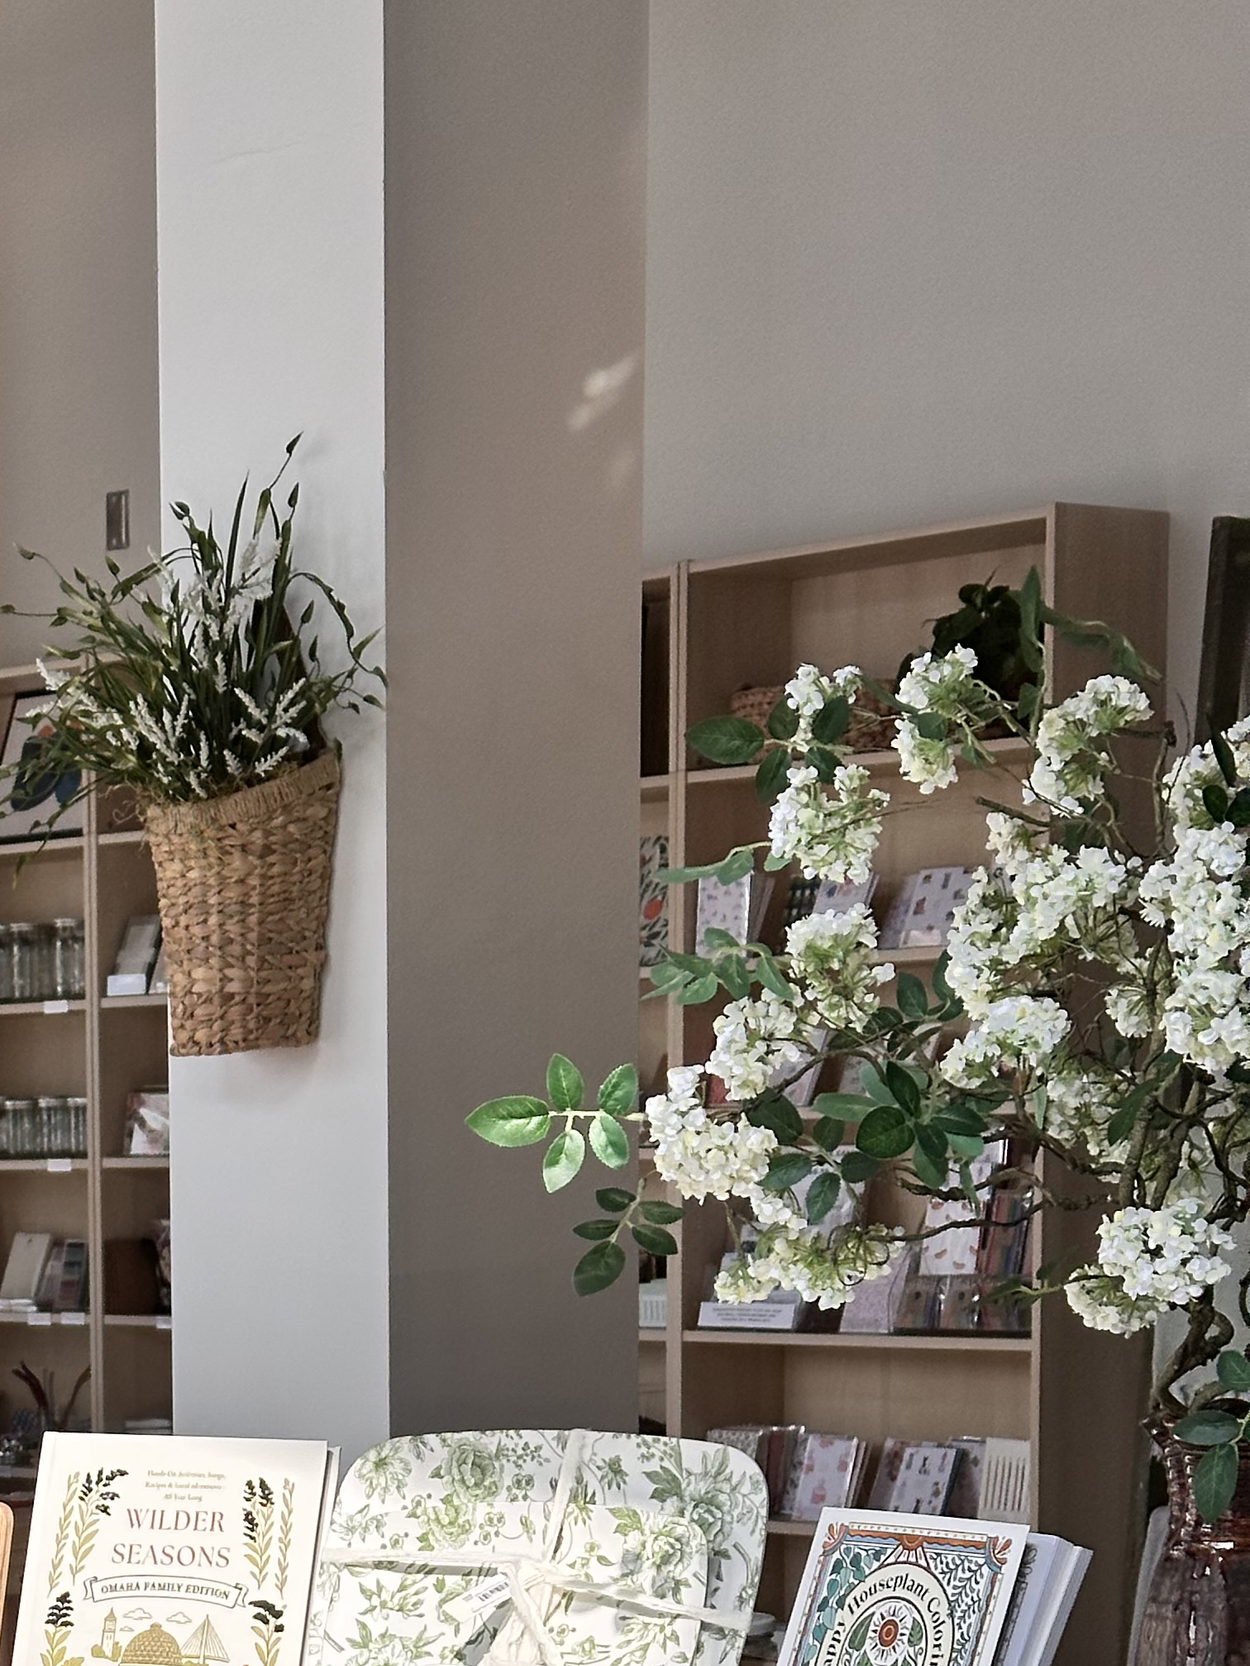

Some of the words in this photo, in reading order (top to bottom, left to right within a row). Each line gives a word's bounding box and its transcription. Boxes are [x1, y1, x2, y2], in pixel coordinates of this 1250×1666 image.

[126, 1508, 225, 1533] WILDER
[111, 1543, 231, 1568] SEASONS
[101, 1581, 141, 1594] OMAHA
[144, 1581, 184, 1593] FAMILY
[185, 1584, 231, 1601] EDITION
[848, 1573, 931, 1616] Houseplant
